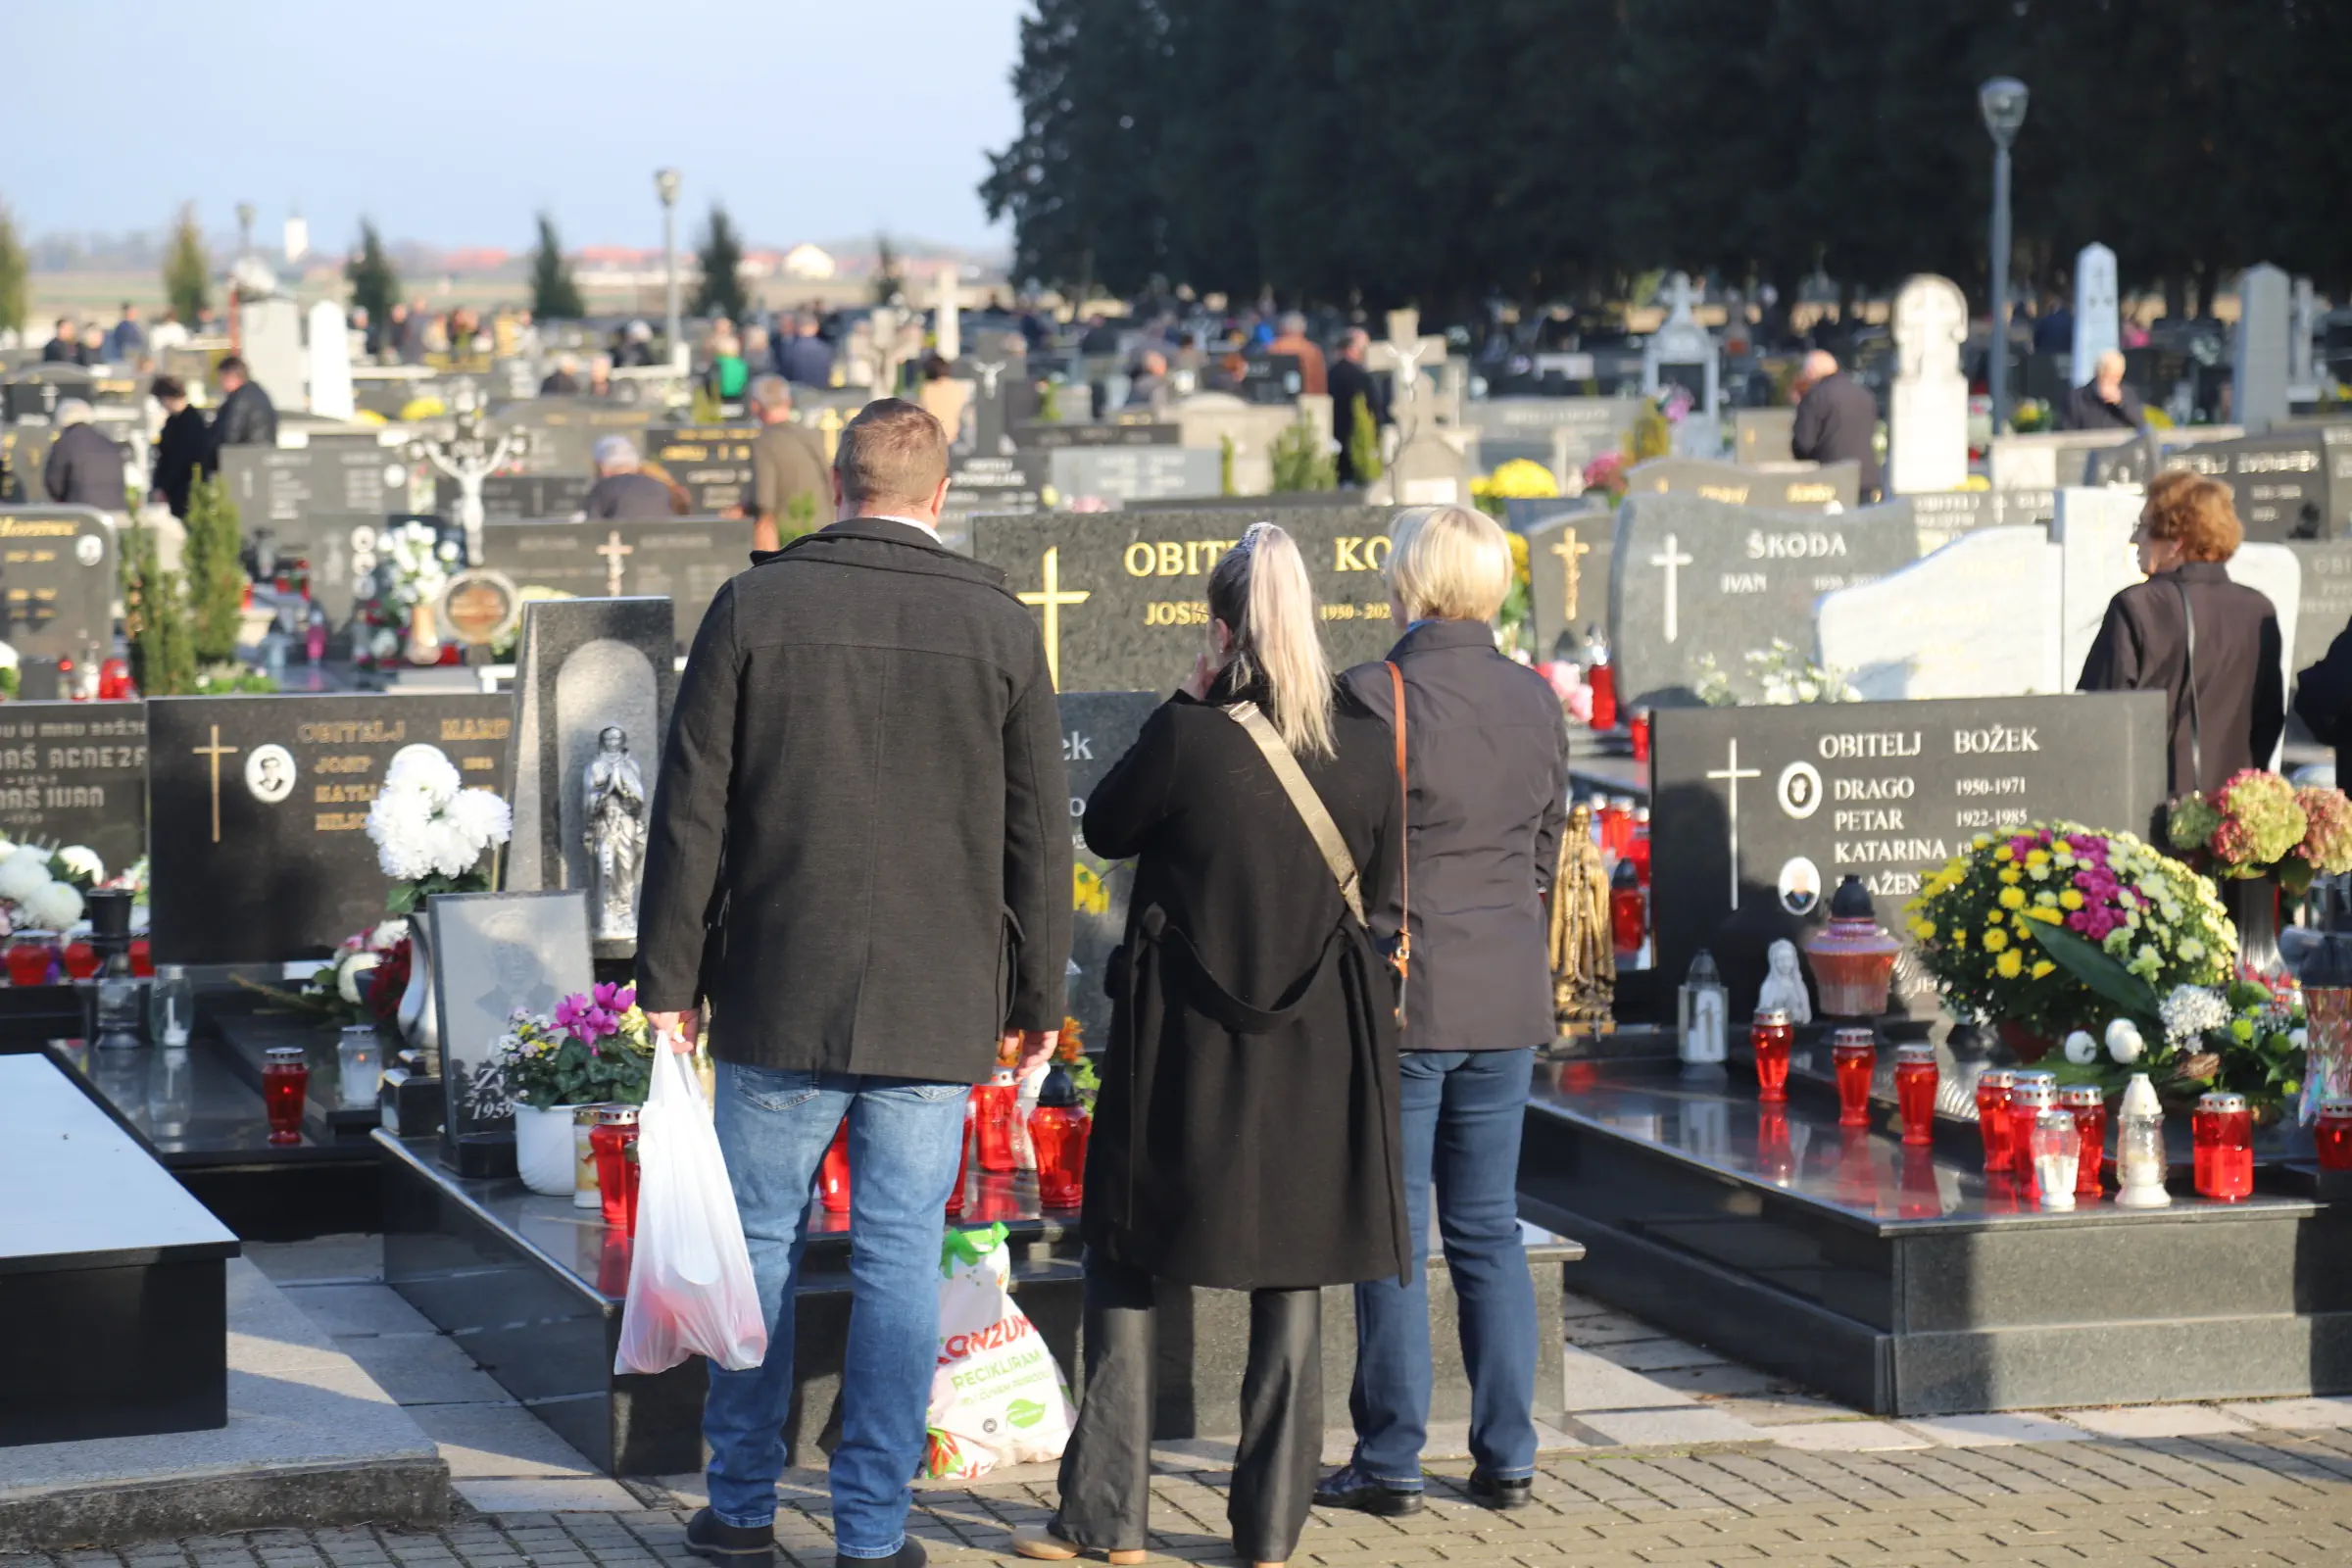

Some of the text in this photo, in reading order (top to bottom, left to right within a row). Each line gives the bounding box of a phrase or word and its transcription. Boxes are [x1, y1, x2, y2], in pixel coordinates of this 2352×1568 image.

[1123, 535, 1394, 577] OBIT KO
[1746, 527, 1847, 560] ŠKODA
[1720, 571, 1768, 594] IVAN
[1818, 723, 2040, 760] OBITELJ BOŽEK
[1834, 776, 2027, 801] DRAGO 1950-1971
[1835, 808, 2028, 832] PETAR 1922-1985
[1834, 838, 1947, 864] KATARINA
